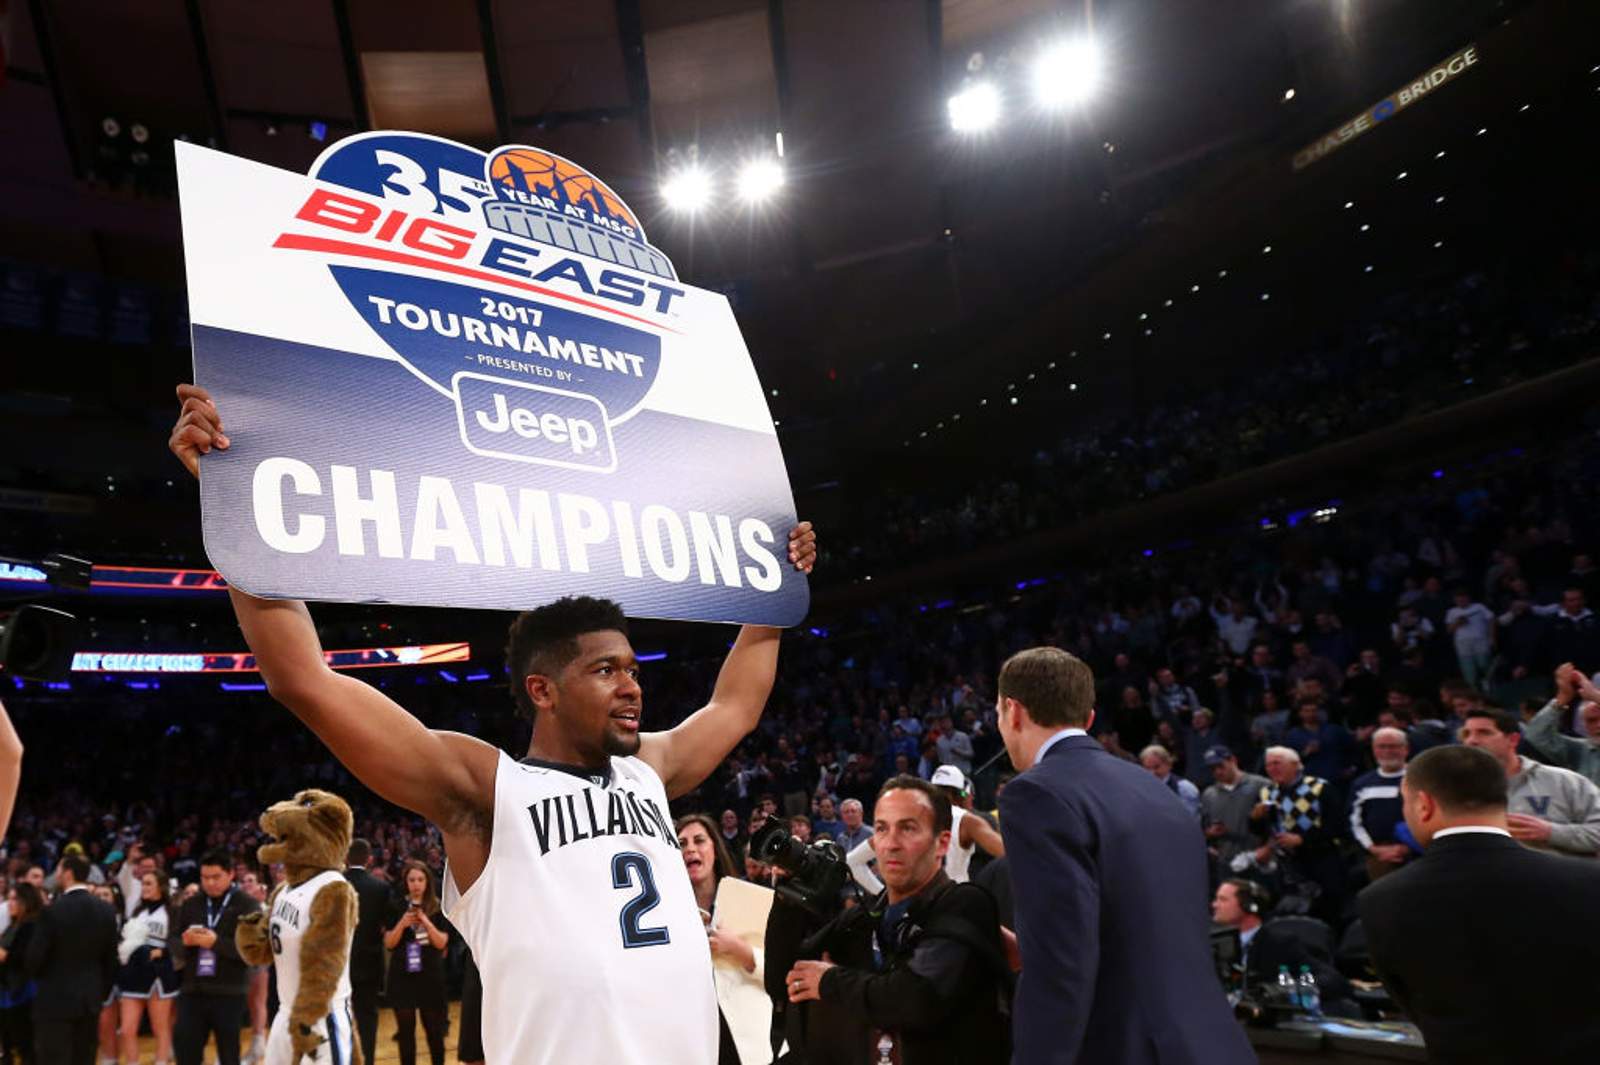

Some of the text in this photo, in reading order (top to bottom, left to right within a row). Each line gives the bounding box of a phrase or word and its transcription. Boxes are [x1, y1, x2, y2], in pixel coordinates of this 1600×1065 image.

[1293, 47, 1479, 170] CHASE BRIDGE
[295, 188, 685, 315] BIG EAST
[501, 188, 636, 239] YEAR AT MSG
[368, 295, 644, 377] TOURNAMENT
[480, 297, 542, 328] 2017
[477, 353, 572, 382] PRESENTED BY
[475, 393, 597, 455] Jeep
[252, 456, 782, 592] CHAMPIONS
[611, 851, 671, 949] 2
